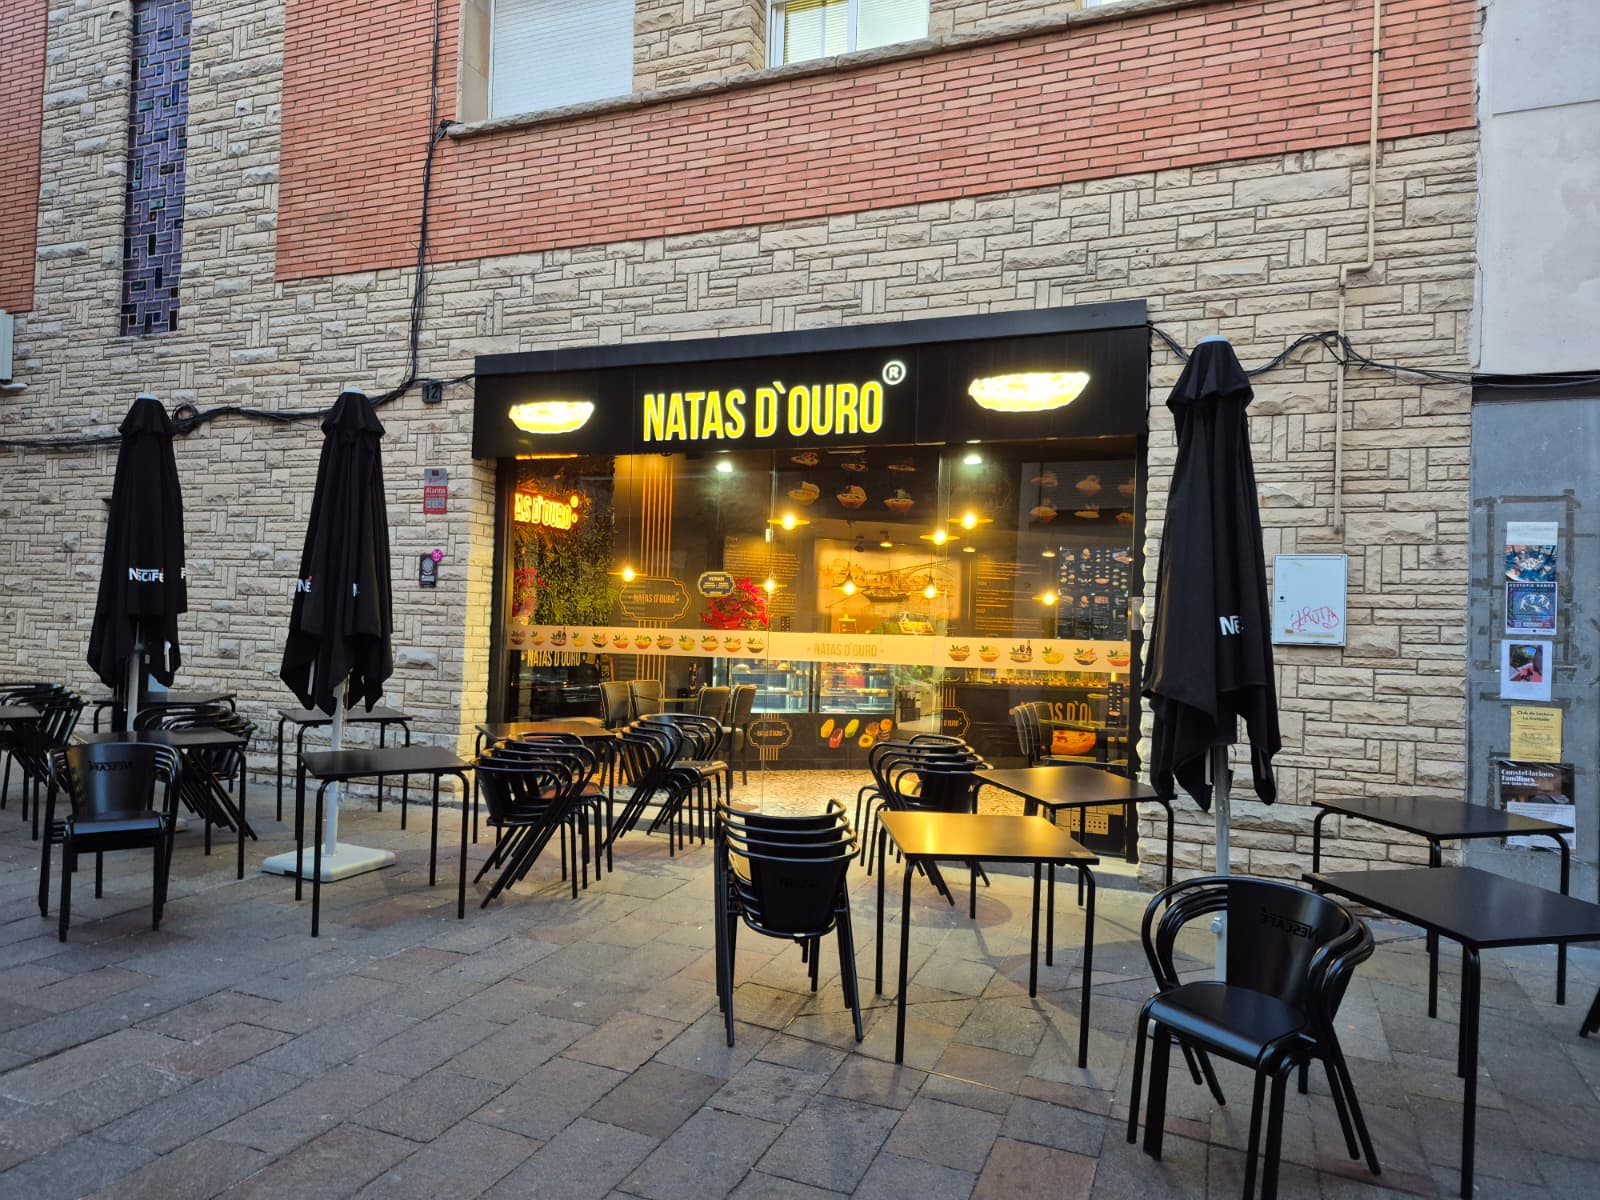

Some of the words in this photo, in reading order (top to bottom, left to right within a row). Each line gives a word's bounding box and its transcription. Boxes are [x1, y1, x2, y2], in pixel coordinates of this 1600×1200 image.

[426, 384, 438, 400] 12
[643, 388, 747, 442] NATAS
[814, 642, 842, 656] NATAS
